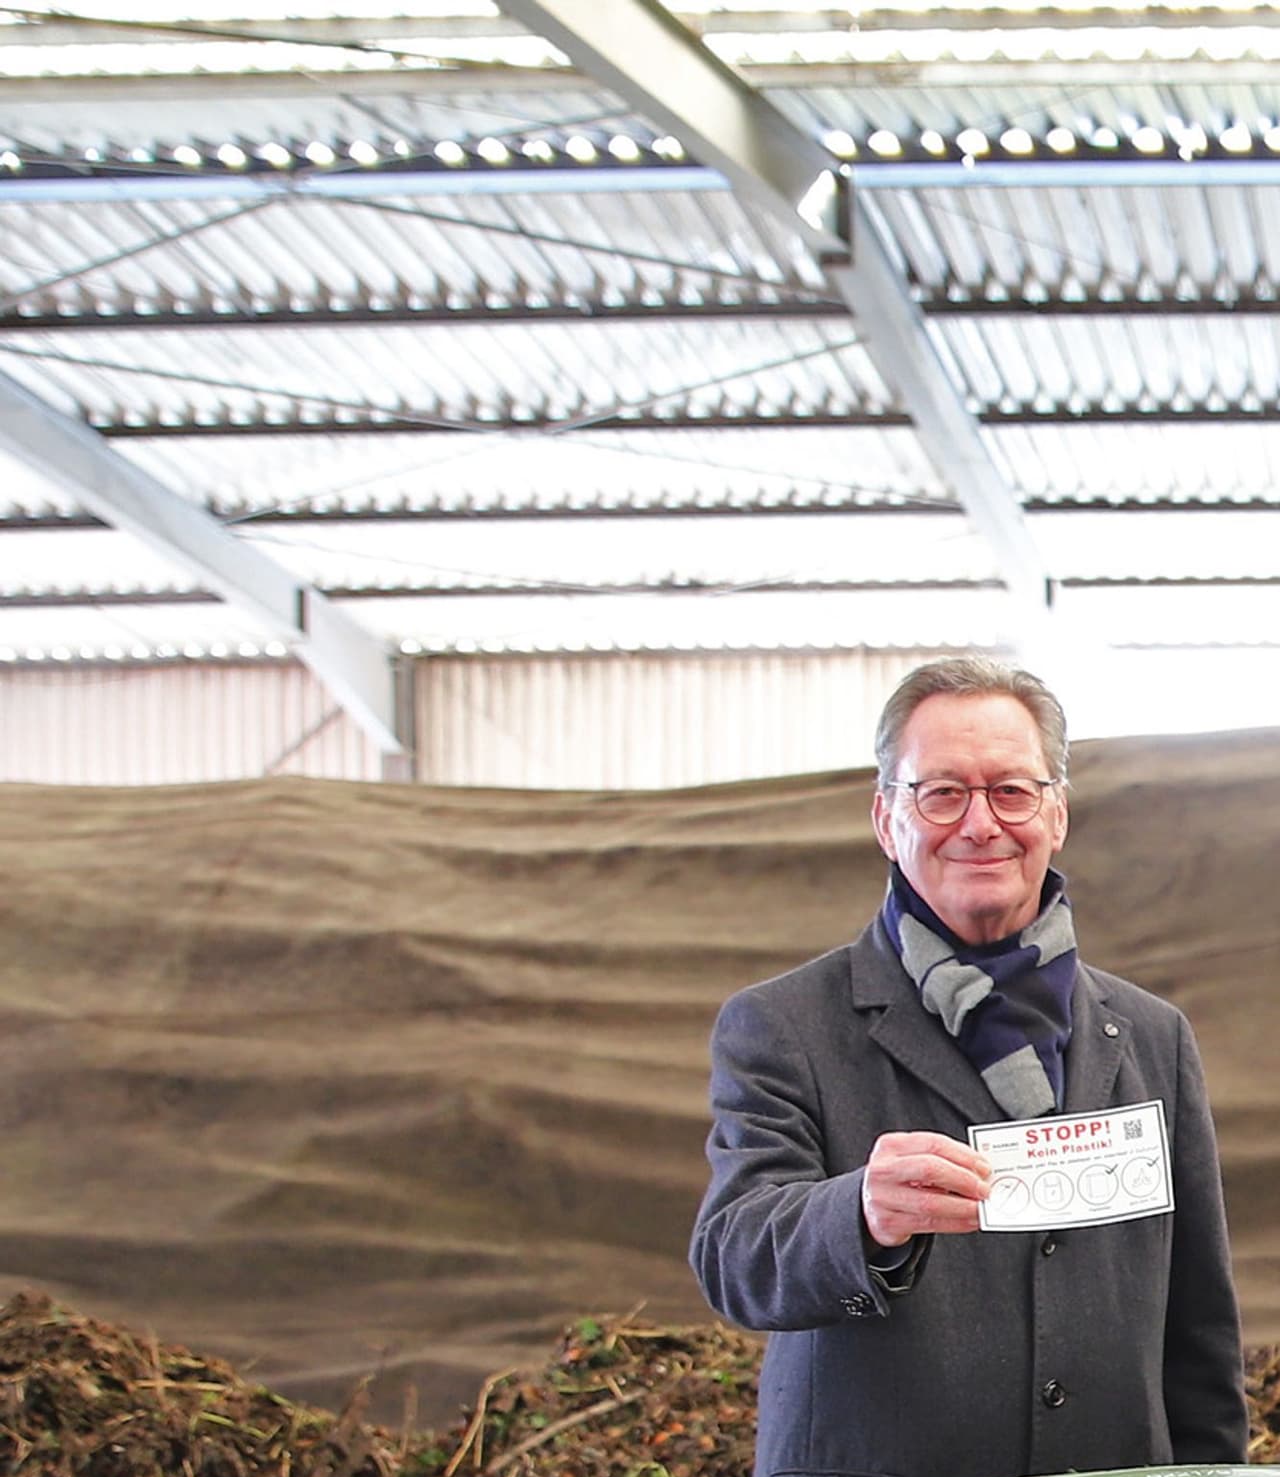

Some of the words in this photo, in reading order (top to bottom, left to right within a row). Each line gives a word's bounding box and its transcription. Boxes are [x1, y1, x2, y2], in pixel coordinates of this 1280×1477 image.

[1026, 1121, 1111, 1144] STOPP!
[1027, 1148, 1057, 1158] Kein
[1061, 1138, 1113, 1154] Plastik!
